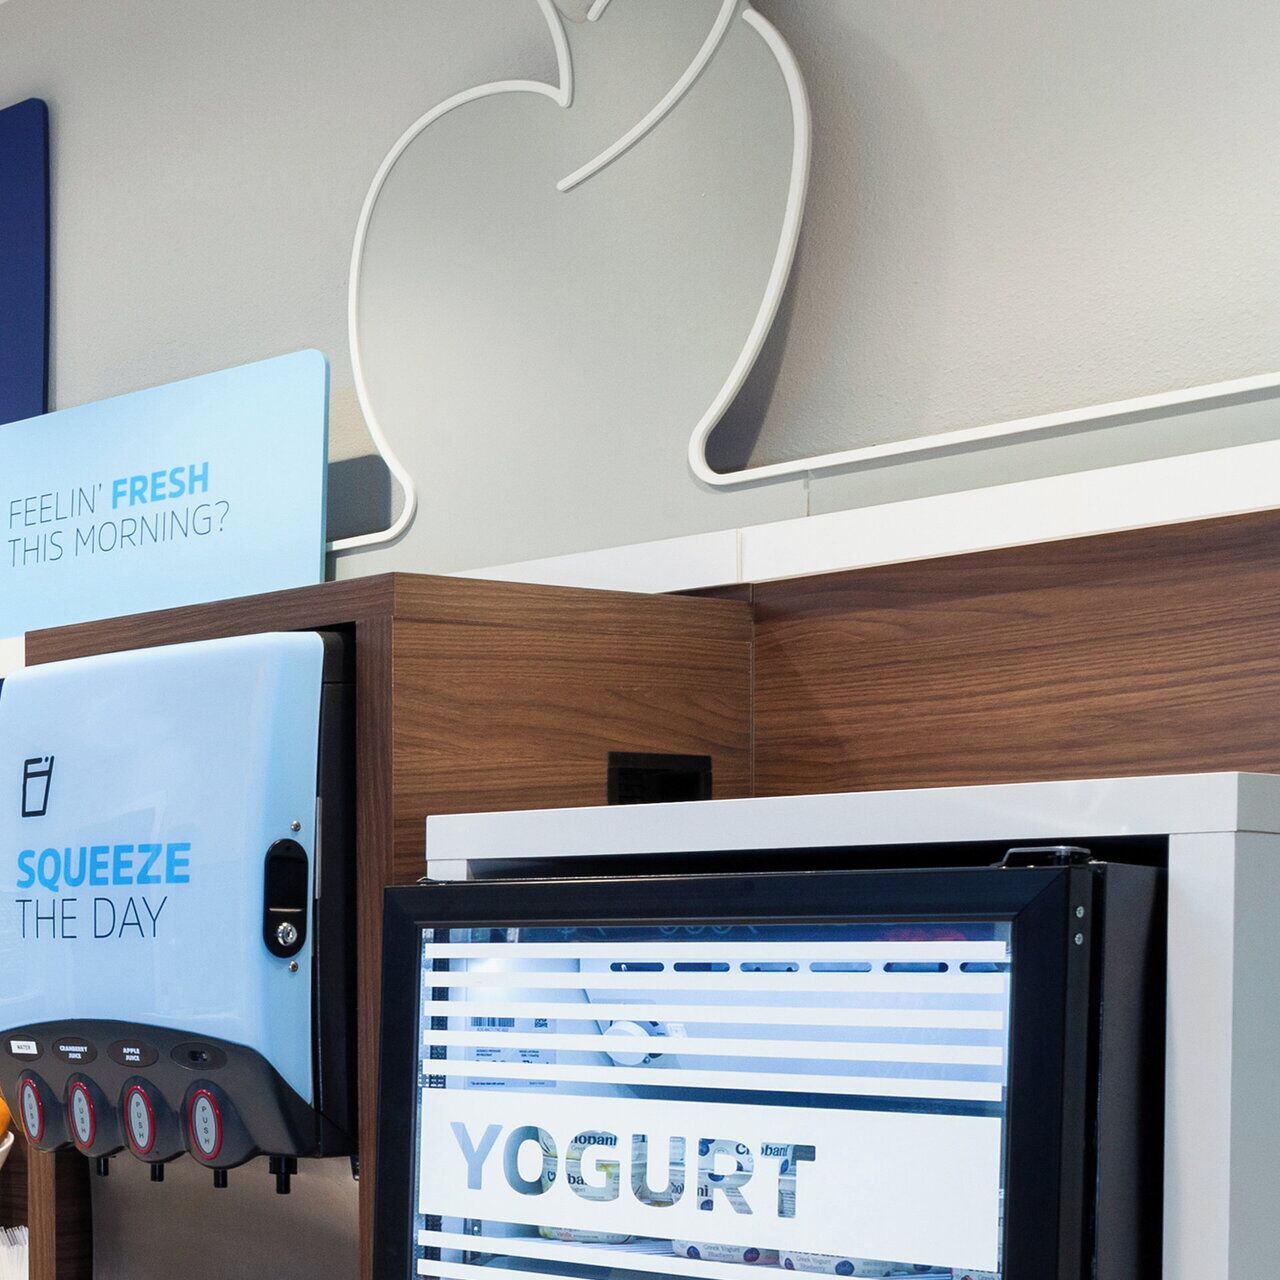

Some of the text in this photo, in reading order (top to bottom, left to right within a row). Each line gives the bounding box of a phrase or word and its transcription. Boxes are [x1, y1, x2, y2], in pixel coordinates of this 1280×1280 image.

[8, 461, 209, 529] FEELIN' FRESH
[7, 500, 231, 568] THIS MORNING?
[16, 842, 192, 893] SQUEEZE
[15, 896, 168, 939] THE DAY
[135, 1101, 144, 1139] PUSH
[201, 1105, 210, 1145] PUSH
[449, 1121, 816, 1219] YOGURT
